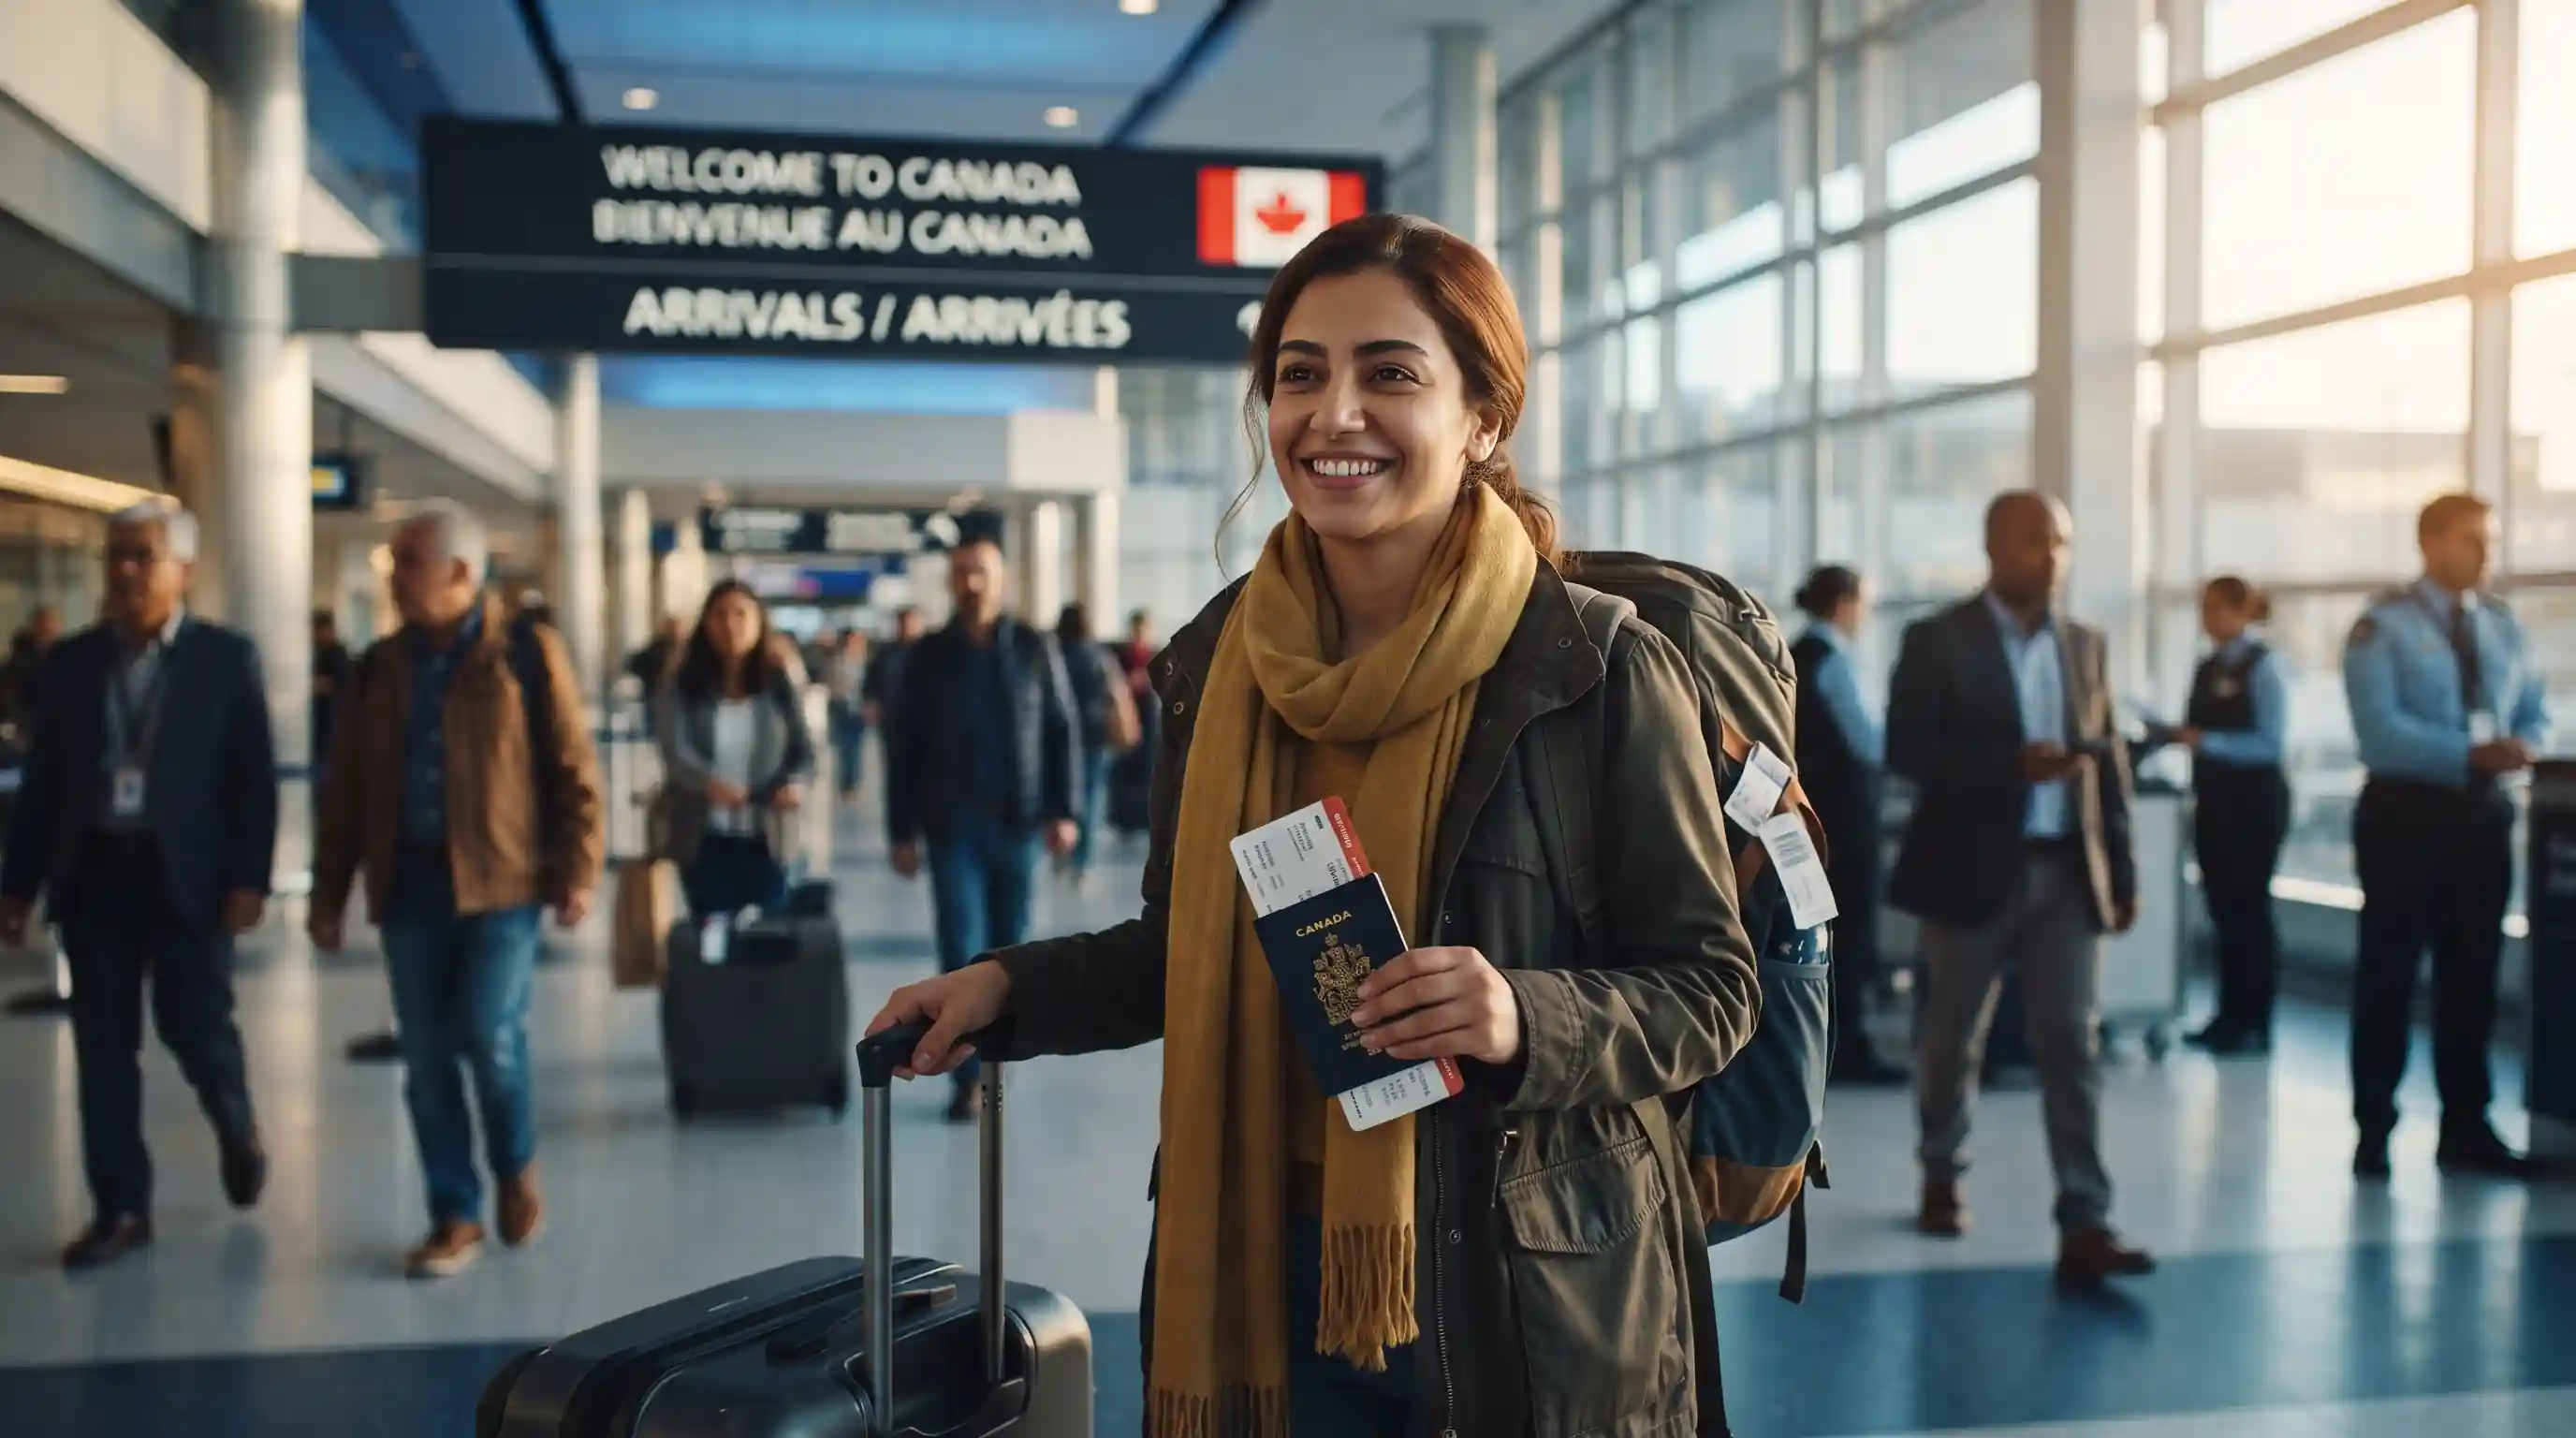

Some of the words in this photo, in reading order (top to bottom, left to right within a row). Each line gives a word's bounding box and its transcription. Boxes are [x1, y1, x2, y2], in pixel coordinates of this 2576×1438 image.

[601, 144, 825, 197] WELCOME
[829, 153, 895, 199] TO
[897, 156, 1081, 206] CANADA
[593, 198, 834, 250] BIENVENUE
[836, 207, 903, 253] AU
[908, 209, 1093, 259] CANADA
[623, 287, 863, 341] ARRIVALS
[870, 295, 896, 341] /
[900, 288, 1131, 348] ARRIVÉES
[1295, 910, 1352, 937] CANADA
